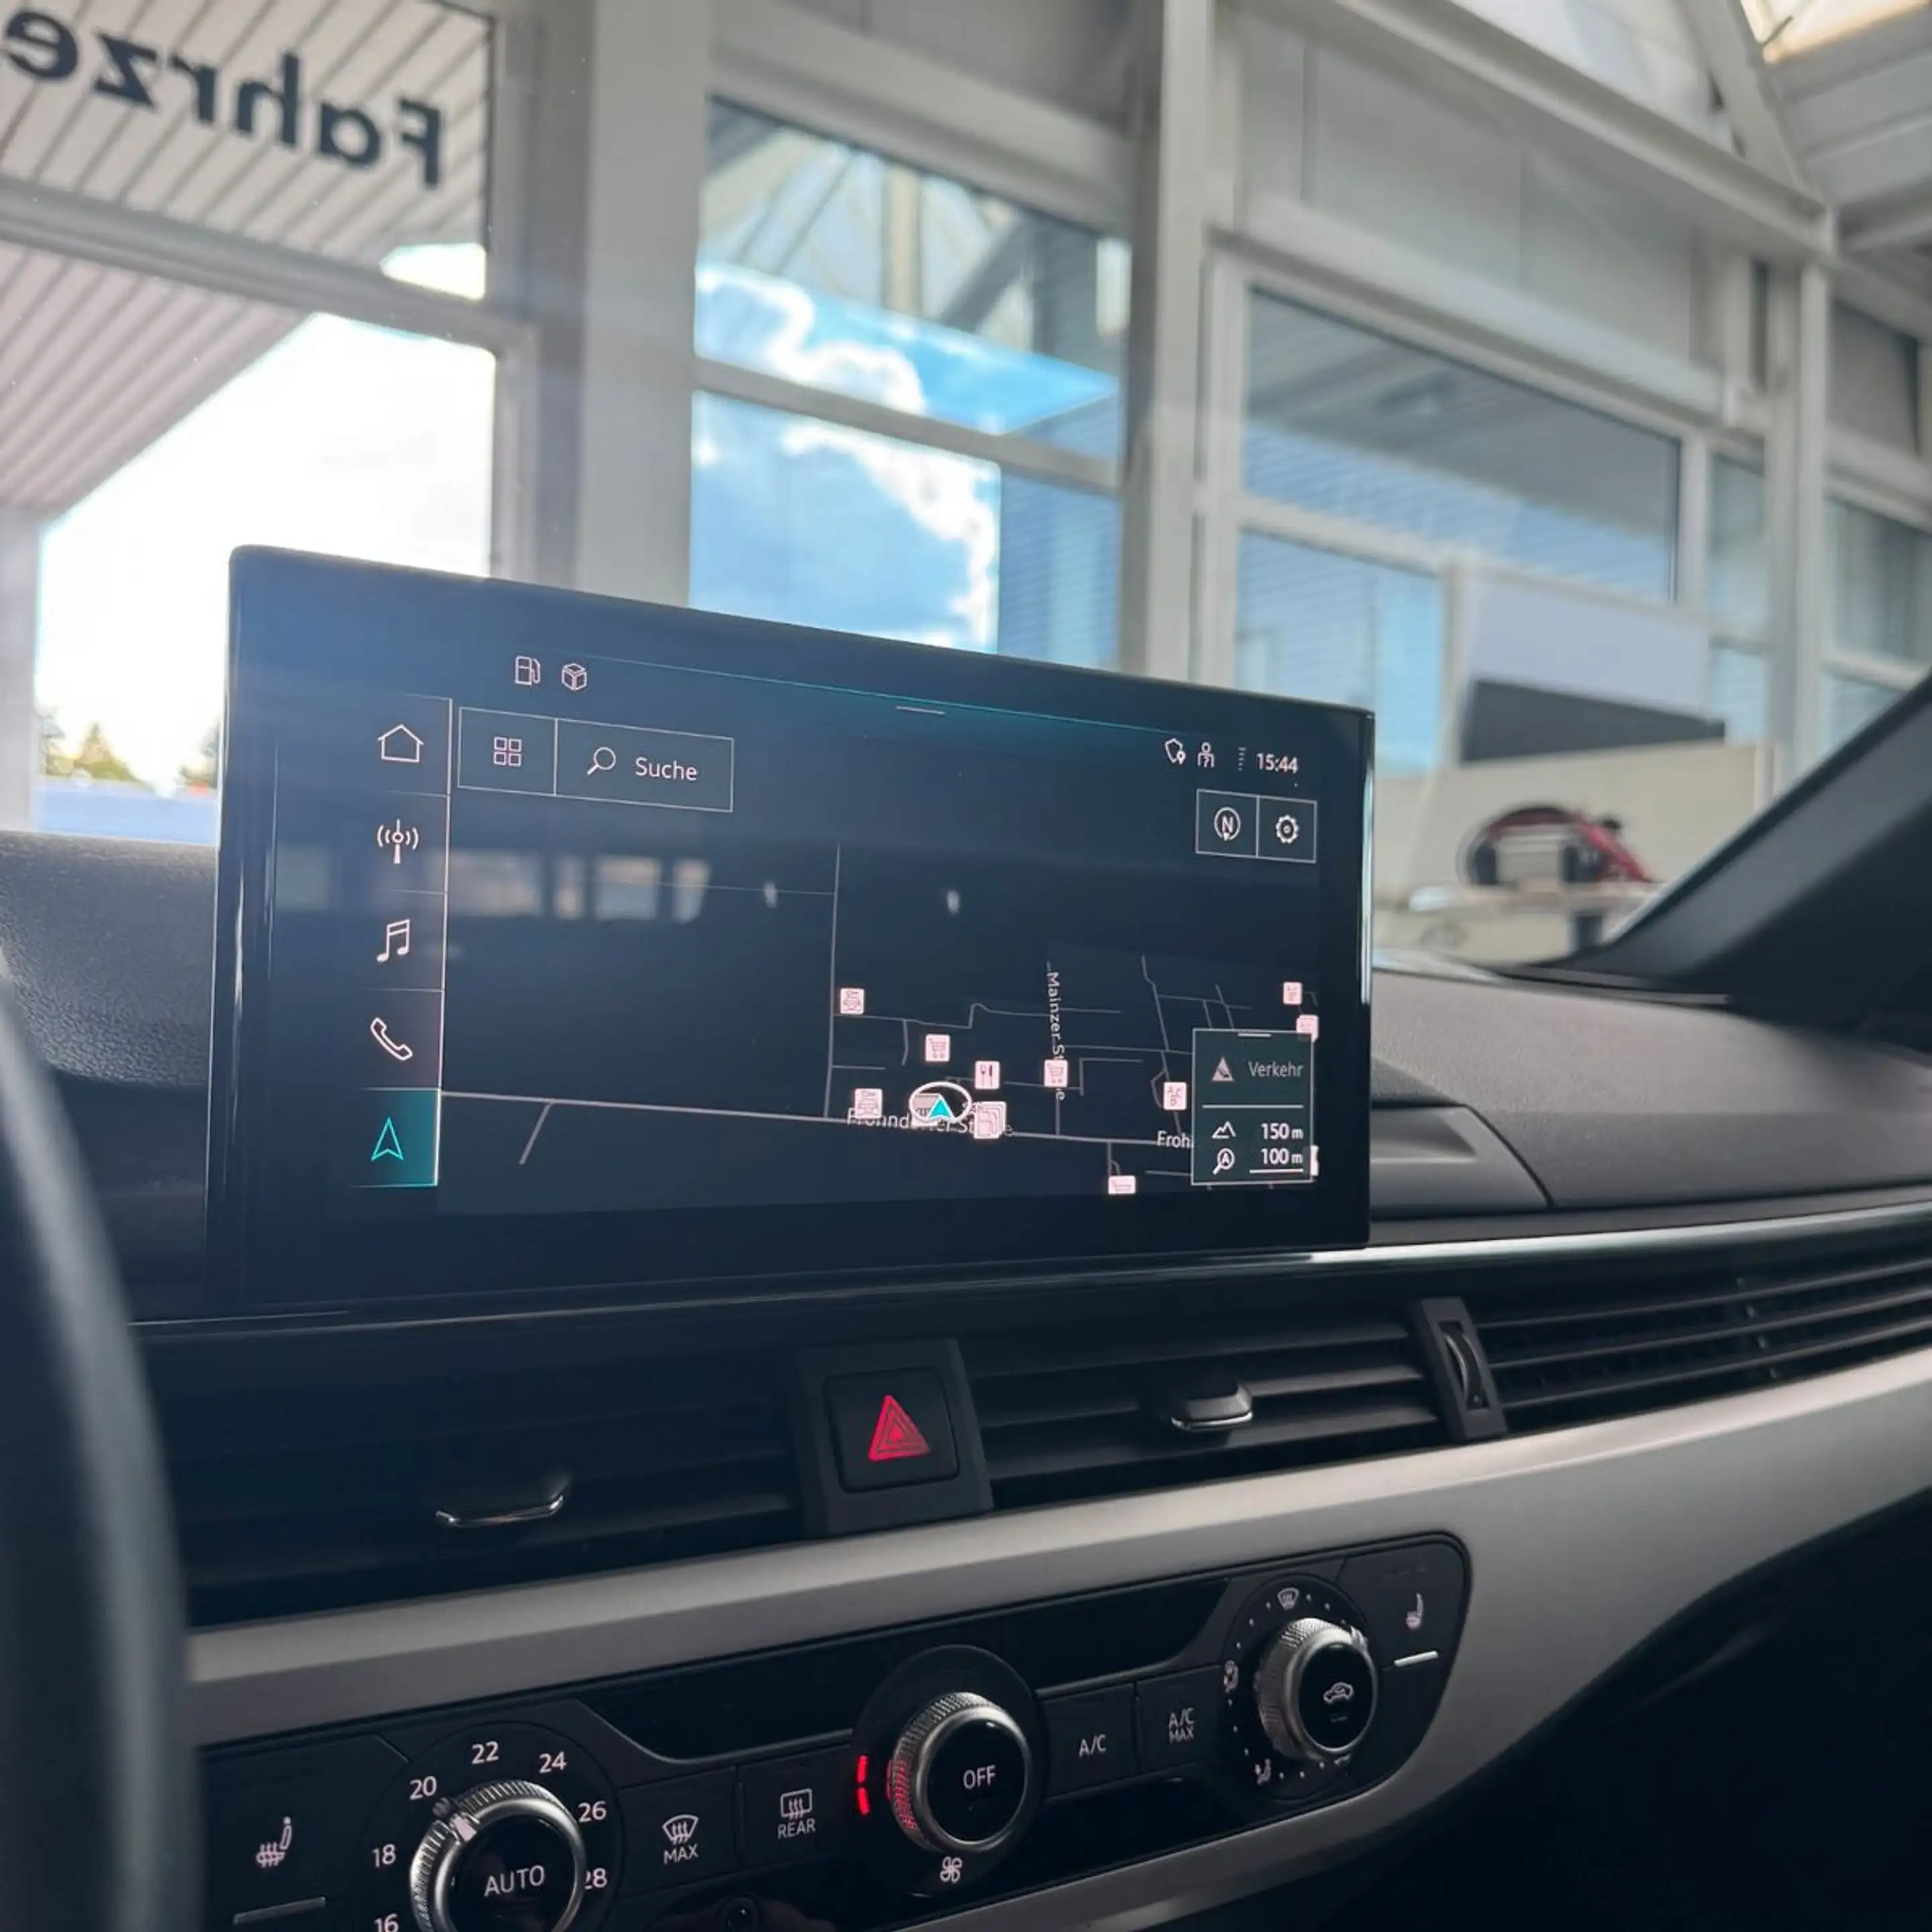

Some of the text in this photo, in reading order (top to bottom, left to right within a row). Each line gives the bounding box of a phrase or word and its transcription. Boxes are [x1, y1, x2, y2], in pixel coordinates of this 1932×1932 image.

[635, 757, 698, 781] Suche
[1256, 752, 1299, 774] 15:44
[1046, 972, 1063, 1040] Mainzer
[1248, 1061, 1304, 1079] Verkehr
[1157, 1130, 1192, 1149] Froh
[1260, 1122, 1304, 1140] 150 m
[1260, 1147, 1304, 1165] 100 m
[1167, 1707, 1195, 1728] A/C
[1079, 1733, 1106, 1757] A/C
[1169, 1725, 1194, 1744] MAX
[472, 1741, 500, 1764] 22
[539, 1751, 567, 1774] 24
[963, 1765, 996, 1789] OFF
[409, 1776, 437, 1801] 20
[578, 1801, 606, 1823] 26
[777, 1819, 816, 1839] REAR
[372, 1843, 396, 1868] 18
[663, 1843, 699, 1865] MAX
[484, 1864, 546, 1897] AUTO
